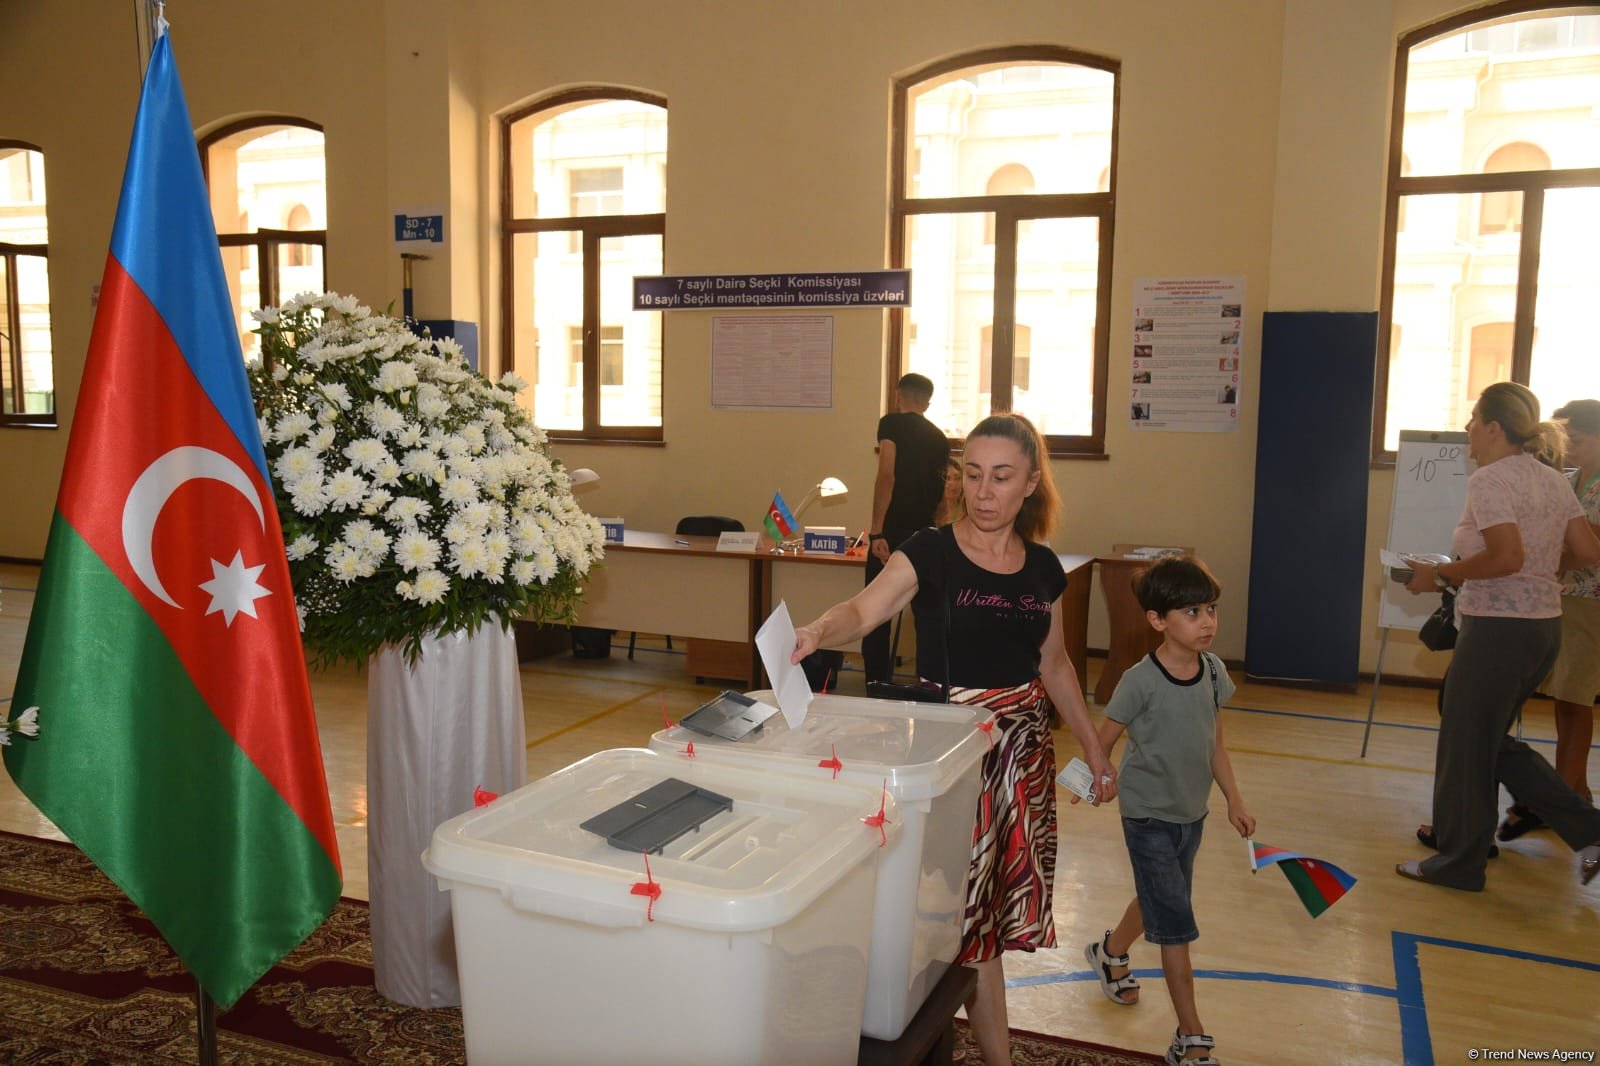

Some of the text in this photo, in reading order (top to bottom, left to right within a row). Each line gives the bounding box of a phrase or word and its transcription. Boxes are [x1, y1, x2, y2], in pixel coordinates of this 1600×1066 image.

[406, 219, 418, 228] SD
[426, 218, 432, 227] 7
[403, 230, 416, 238] Mn
[424, 228, 435, 238] 10
[677, 276, 861, 291] 7 saylı Dairə Seçki Komissiyası
[640, 294, 652, 305] 10
[655, 294, 680, 306] saylı
[683, 293, 714, 306] Seçki
[798, 290, 859, 304] komissiya
[864, 290, 904, 302] üzvləri
[1234, 320, 1241, 329] 2
[1134, 334, 1140, 343] 3
[1133, 360, 1139, 368] 5
[1232, 374, 1238, 383] 6
[1230, 408, 1236, 417] 8
[811, 538, 838, 549] KATİB
[956, 588, 1013, 608] Written
